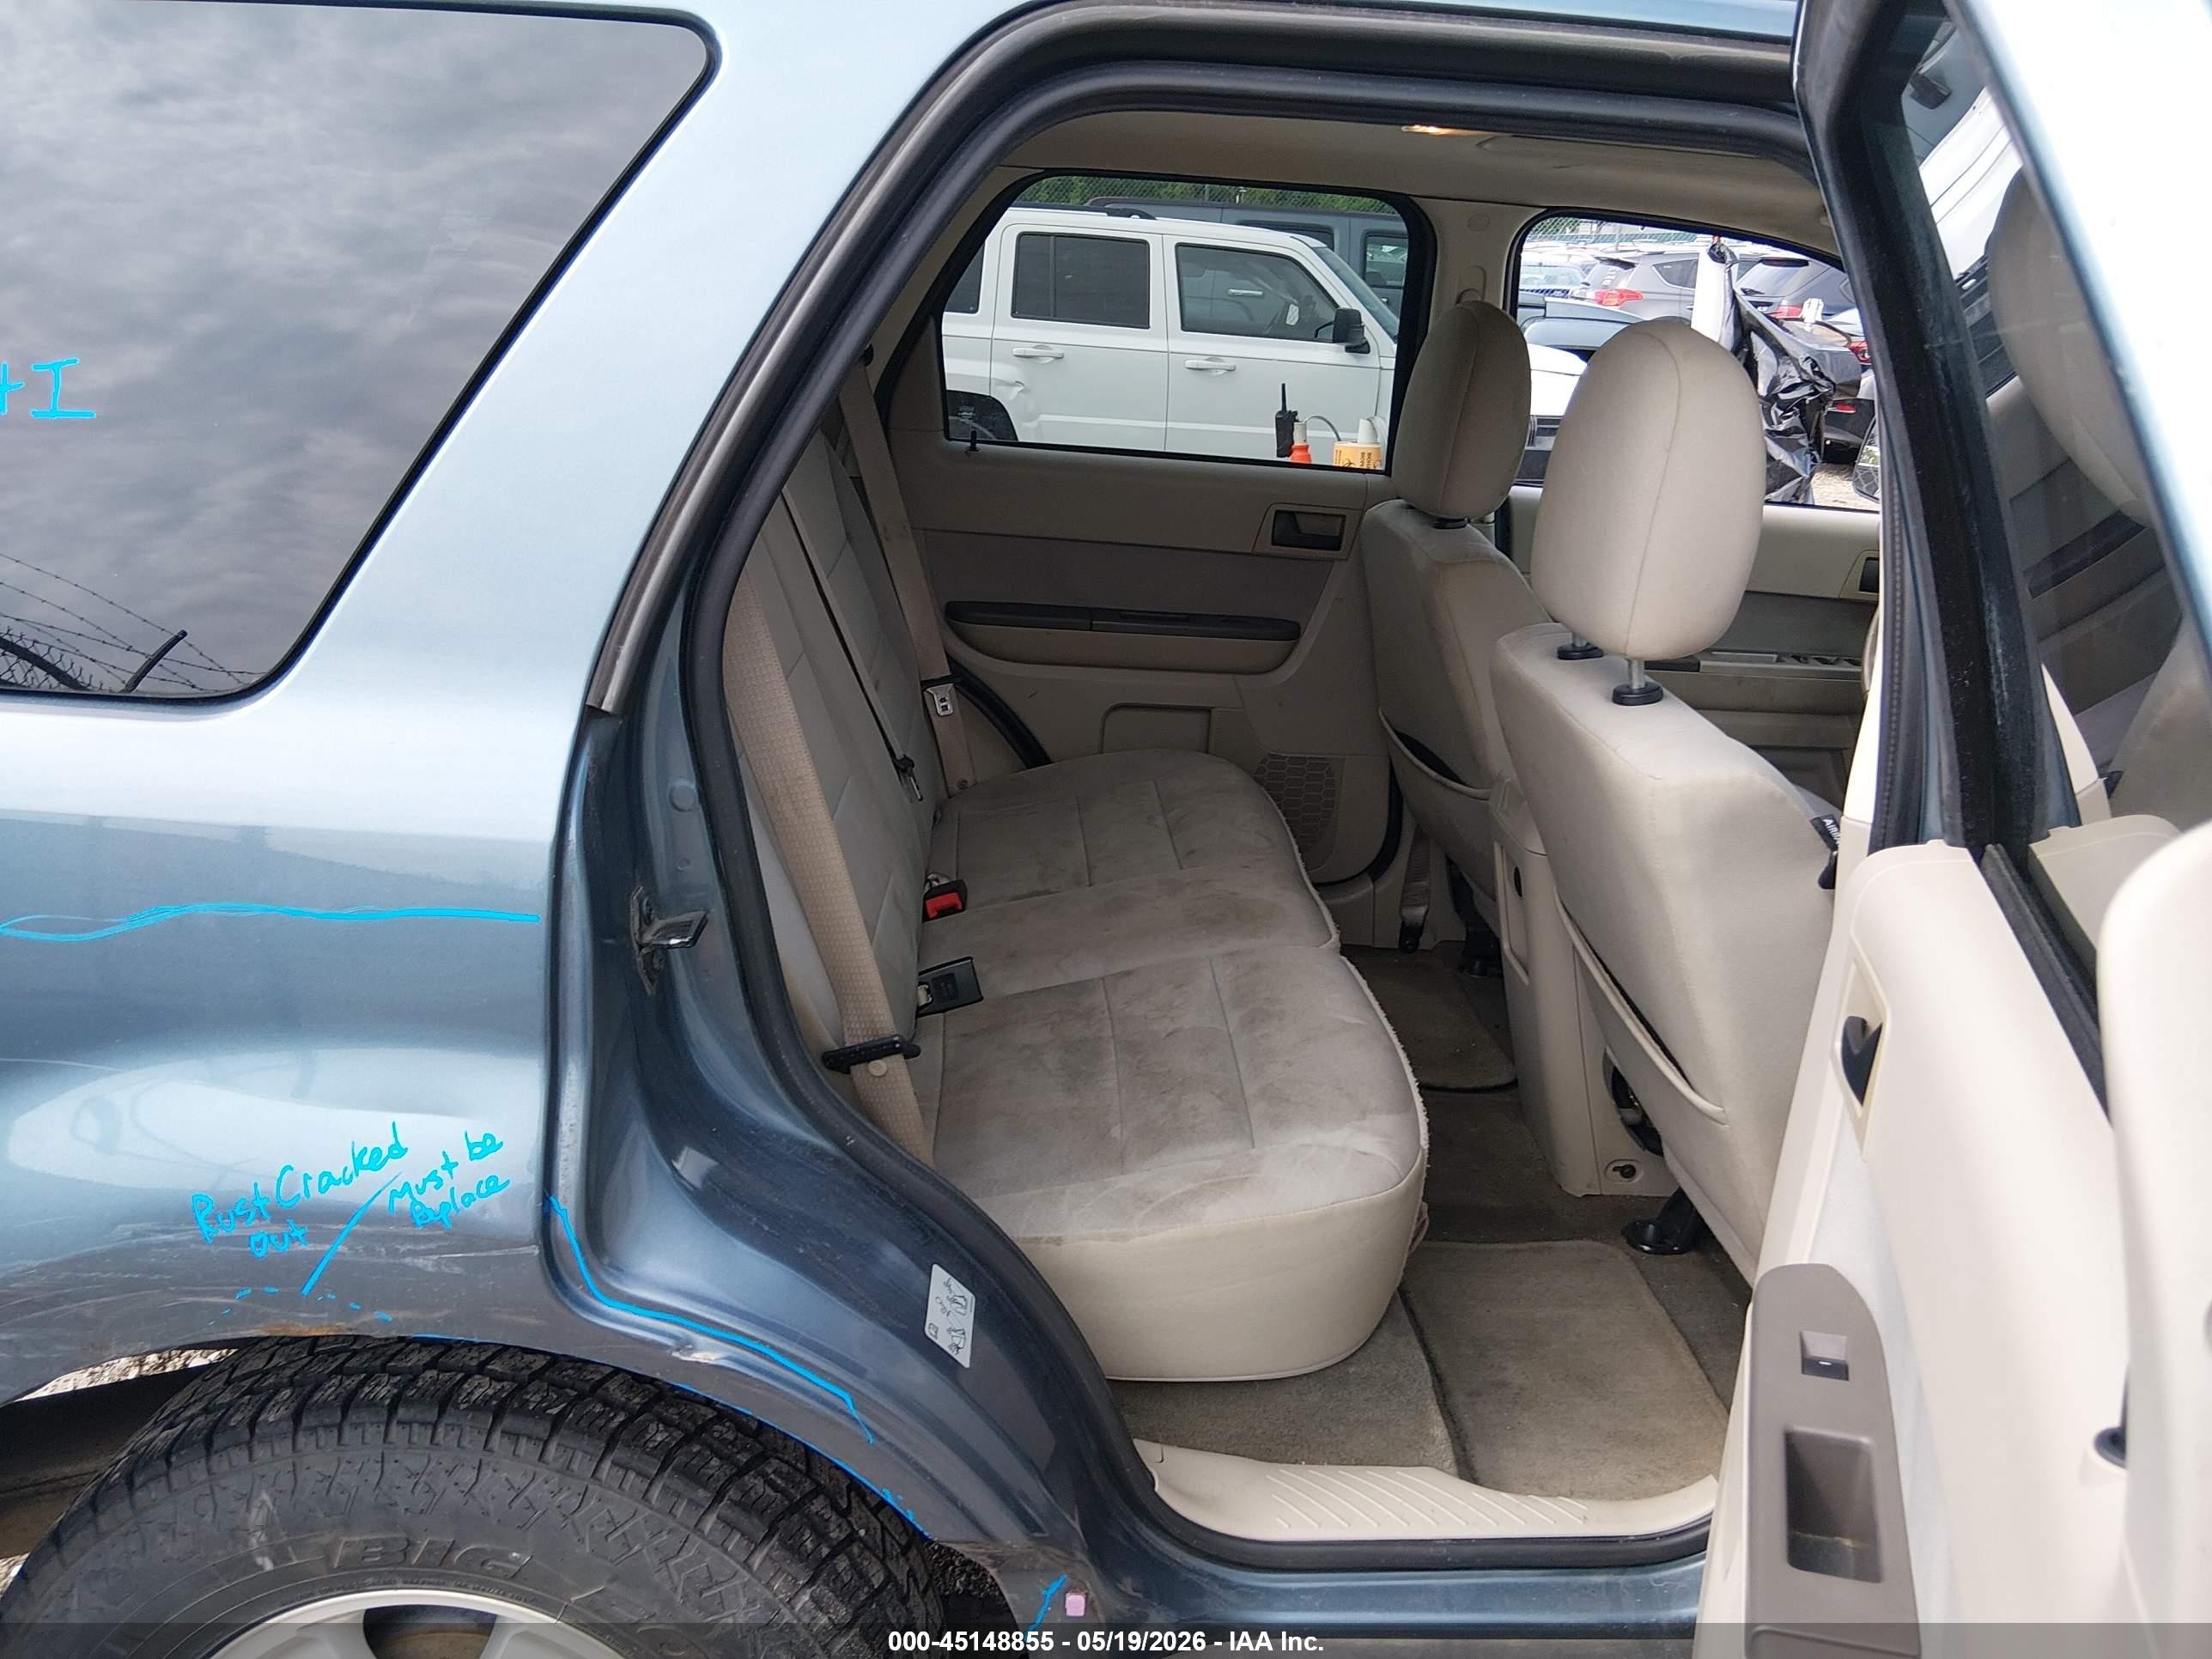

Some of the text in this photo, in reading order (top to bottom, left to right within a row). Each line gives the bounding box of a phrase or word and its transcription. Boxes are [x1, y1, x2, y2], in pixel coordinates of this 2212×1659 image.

[464, 1131, 504, 1162] be
[191, 1121, 409, 1244] Rust Cracked
[332, 1534, 534, 1578] BIG
